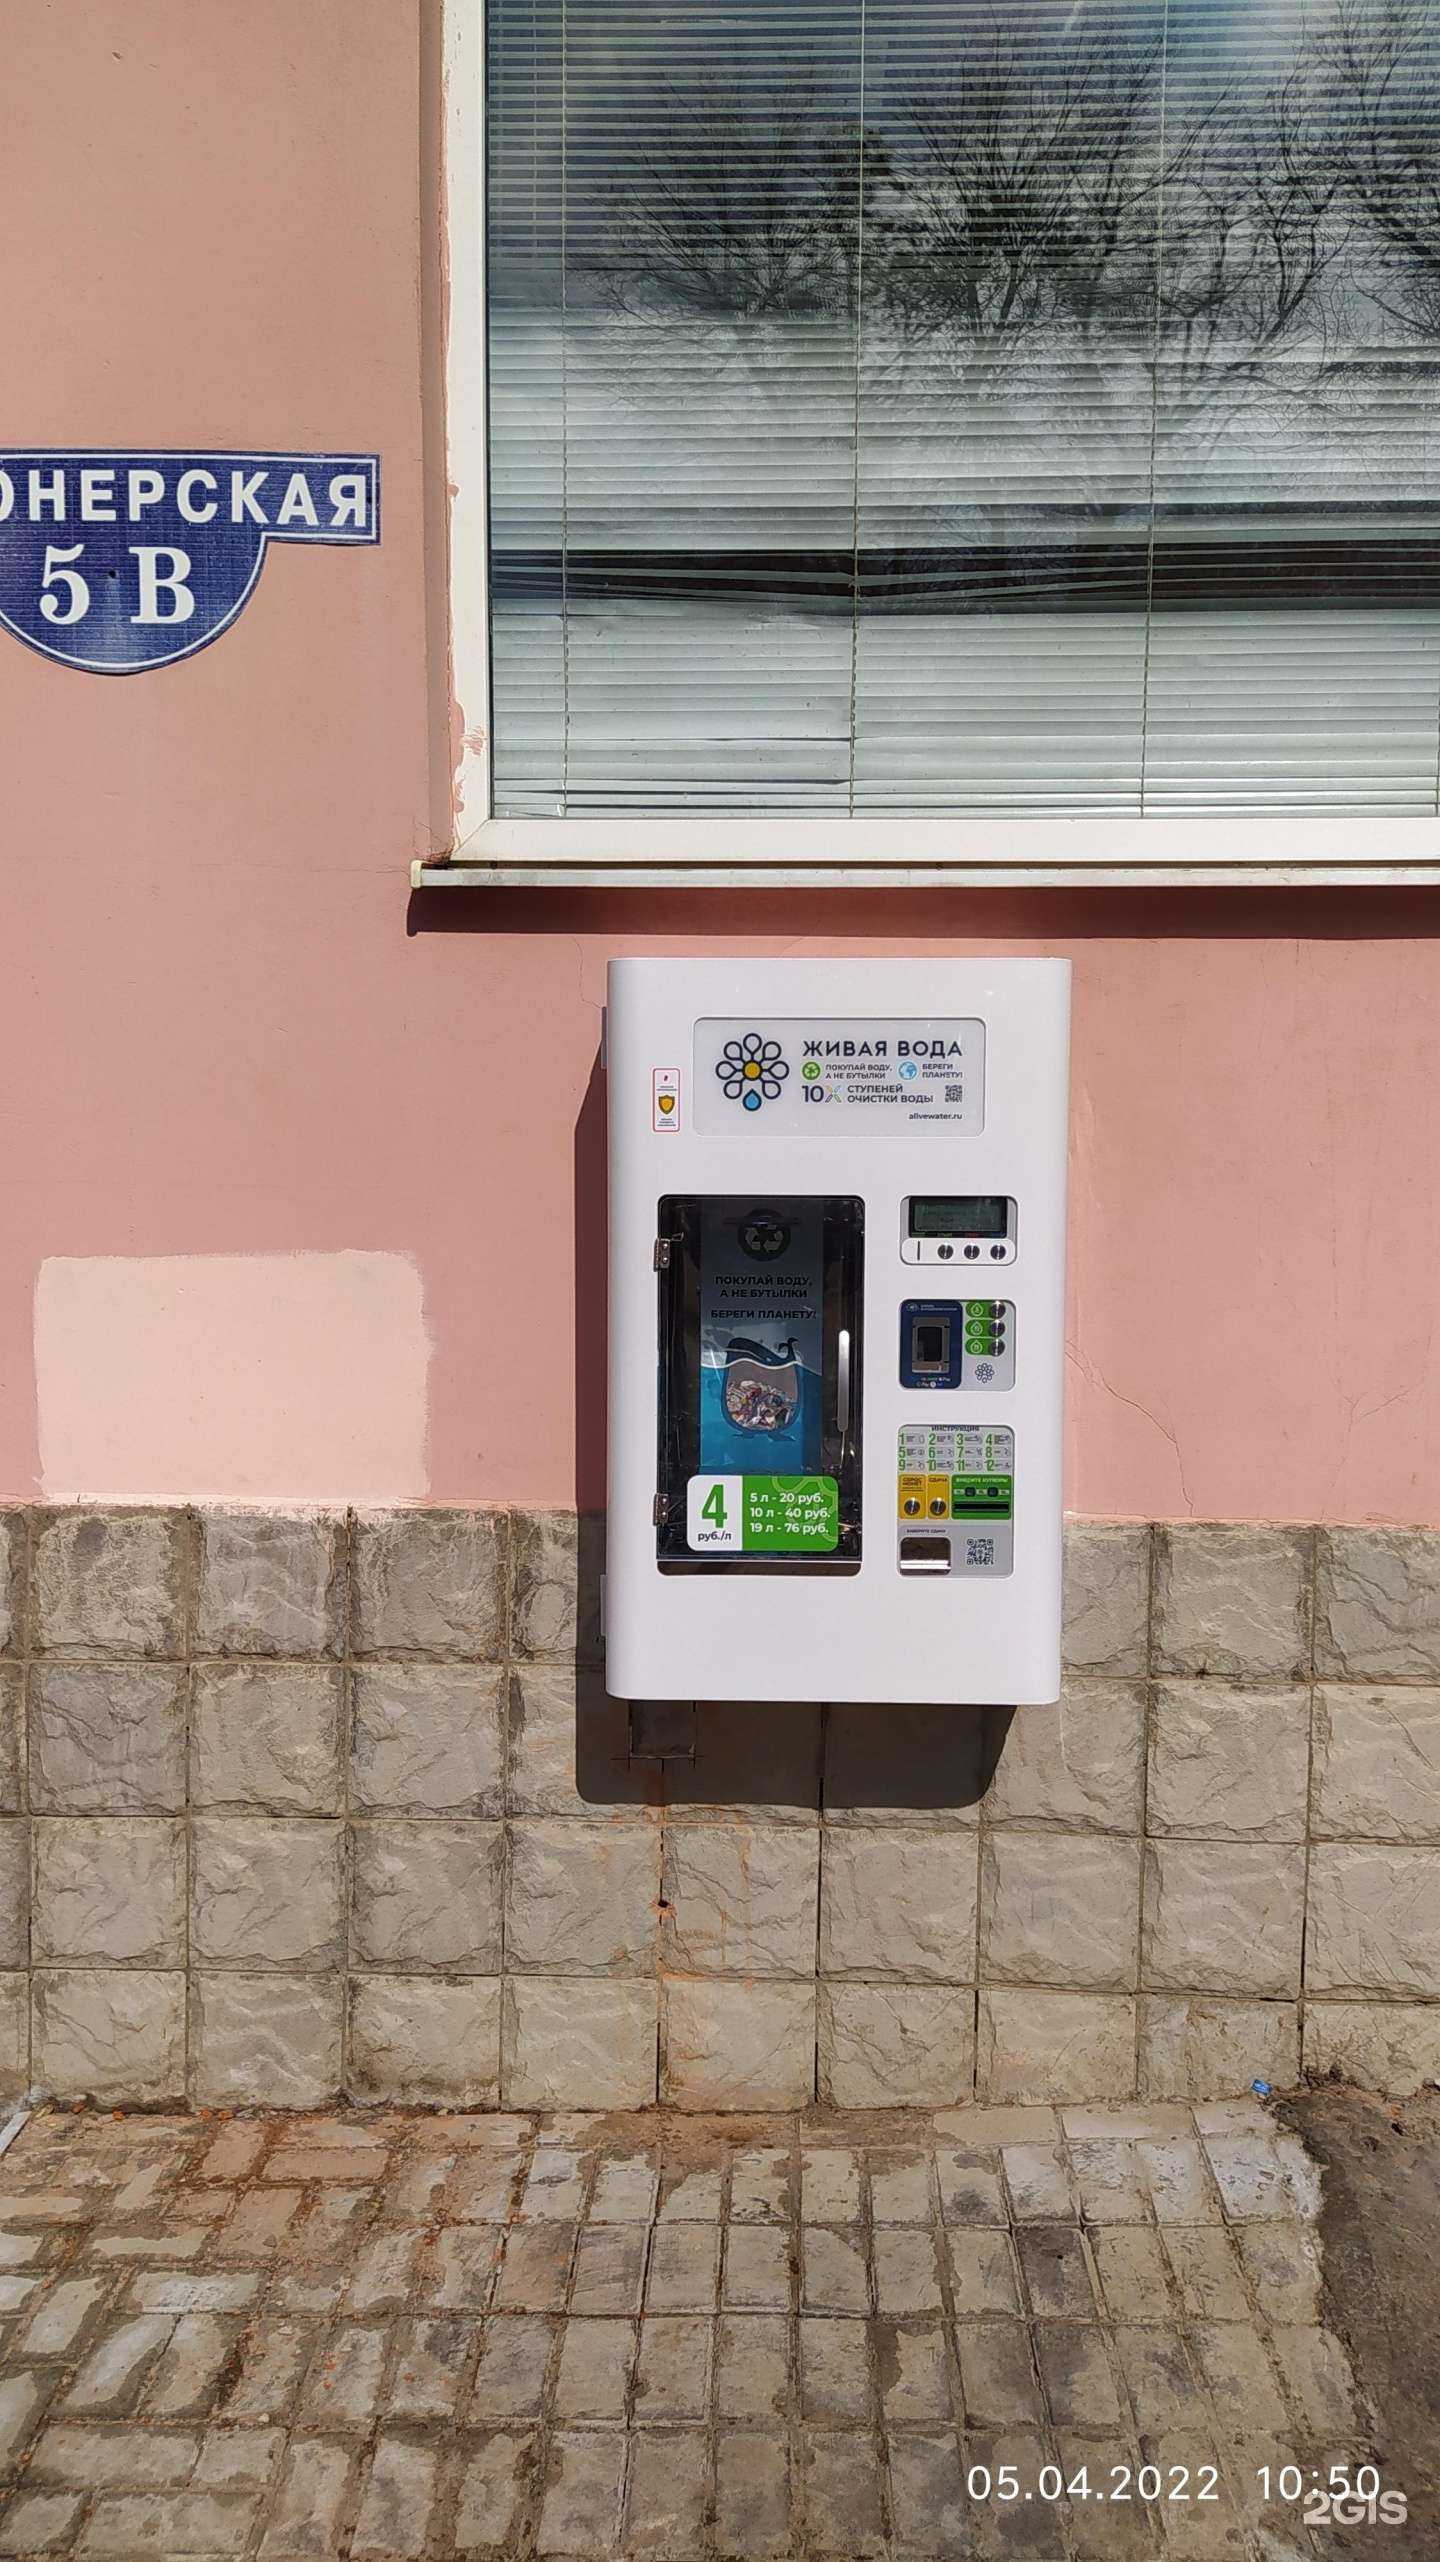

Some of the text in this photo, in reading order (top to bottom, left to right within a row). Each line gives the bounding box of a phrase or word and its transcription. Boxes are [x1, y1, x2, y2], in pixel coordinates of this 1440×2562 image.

[39, 543, 195, 625] 5 В
[802, 1040, 963, 1058] ЖИВАЯ ВОДА
[826, 1063, 893, 1072] ПОКУПАЙ ВОДУ,
[847, 1083, 903, 1093] СТУПЕНЕЙ
[847, 1095, 934, 1104] ОЧИСТКИ ВОДЫ
[909, 1112, 963, 1120] alivewater.ru
[715, 1275, 812, 1286] ПОКУПАЙ ВОДУ,
[720, 1289, 807, 1298] А НЕ БУТЫЛКИ
[711, 1309, 816, 1319] БЕРЕГИ ПЛАНЕТУ!
[898, 1433, 904, 1445] 1
[929, 1433, 936, 1445] 2
[956, 1433, 964, 1445] 3
[985, 1433, 993, 1445] 4
[899, 1446, 906, 1458] 5
[928, 1446, 935, 1458] 6
[957, 1446, 964, 1458] 7
[985, 1446, 992, 1458] 8
[898, 1459, 906, 1471] 9
[750, 1493, 757, 1502] 5
[780, 1493, 795, 1503] 20
[798, 1493, 824, 1505] руб.
[701, 1484, 728, 1528] 4
[751, 1508, 763, 1517] 10
[785, 1508, 801, 1518] 40
[805, 1508, 831, 1520] руб.
[751, 1523, 761, 1532] 19
[784, 1523, 800, 1533] 76
[803, 1523, 829, 1535] руб.
[698, 1531, 731, 1542] руб./л
